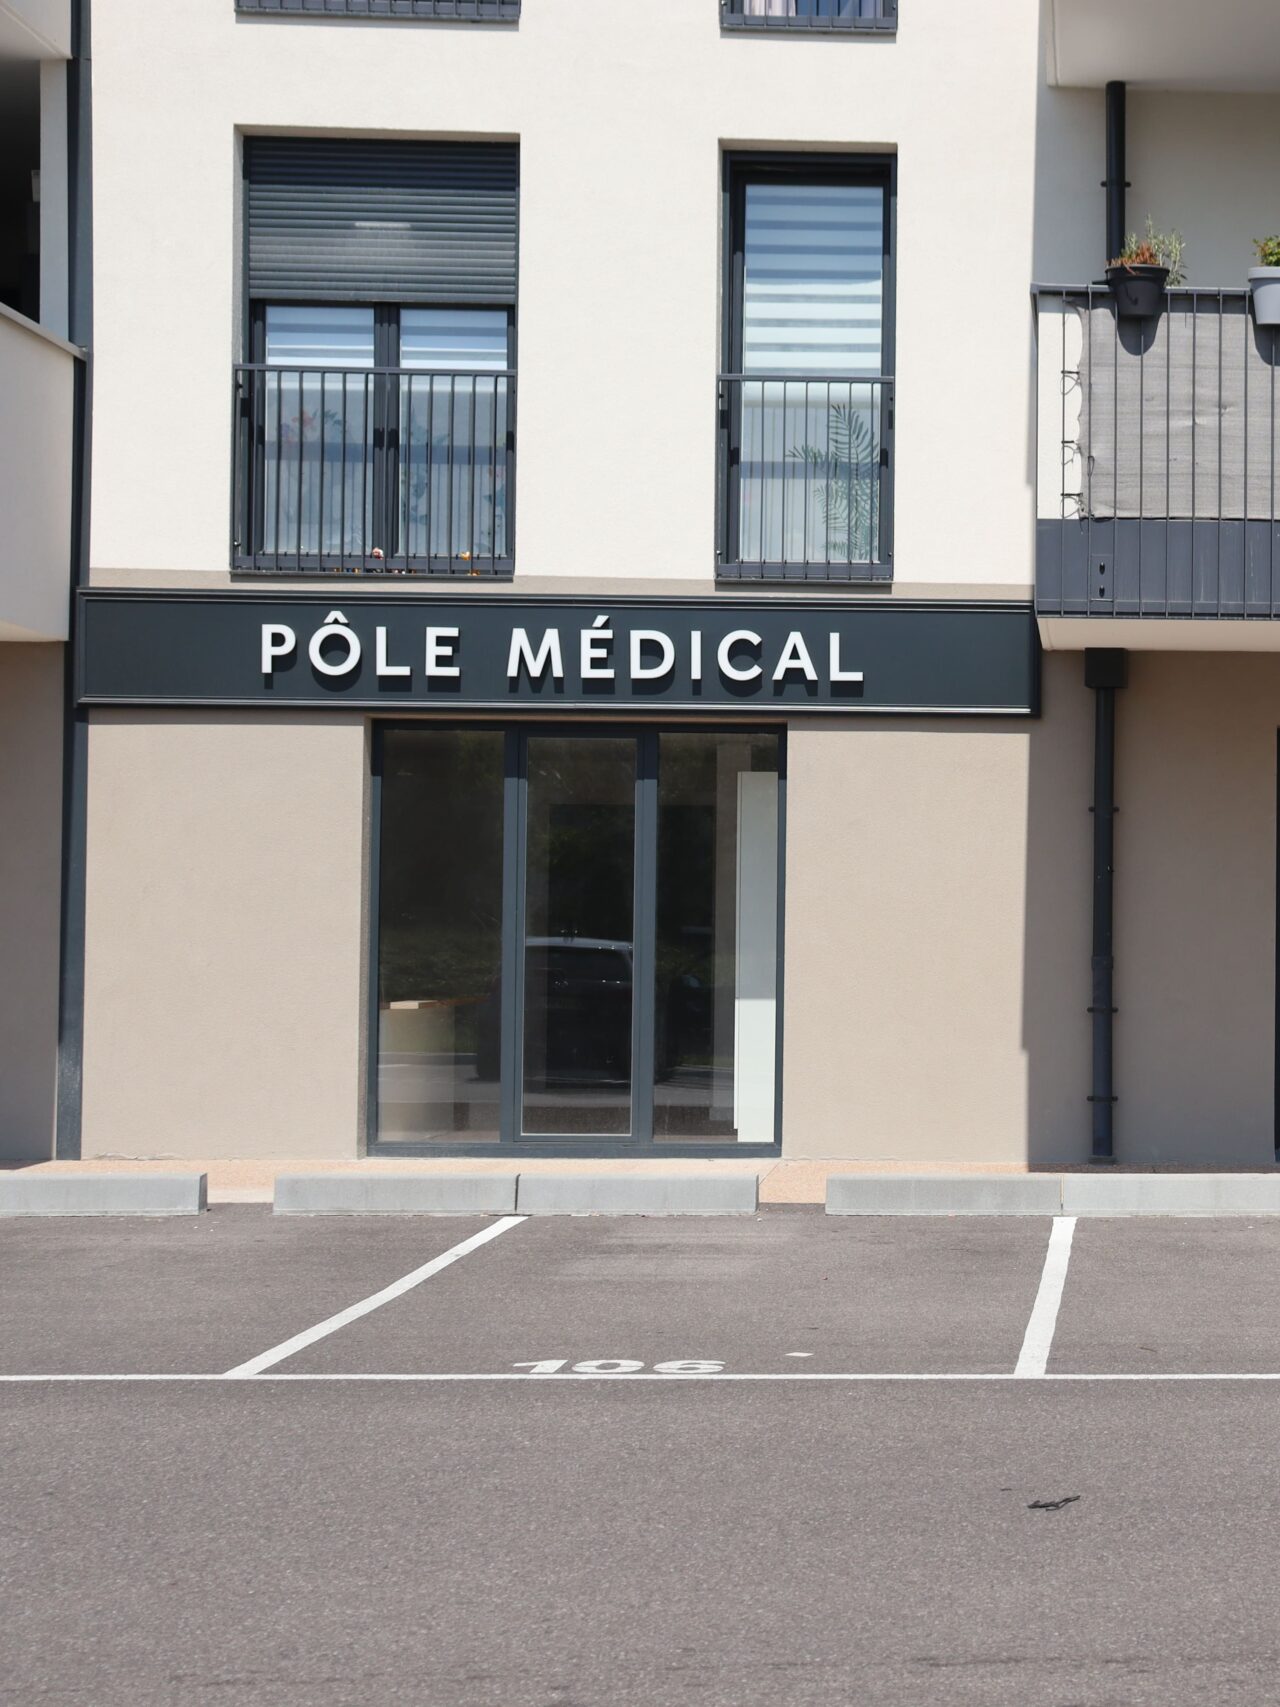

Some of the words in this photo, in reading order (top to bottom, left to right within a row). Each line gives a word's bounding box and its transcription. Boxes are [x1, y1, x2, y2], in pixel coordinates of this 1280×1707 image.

[261, 610, 461, 677] PÔLE
[506, 615, 864, 681] MÉDICAL
[513, 1359, 726, 1374] 106
